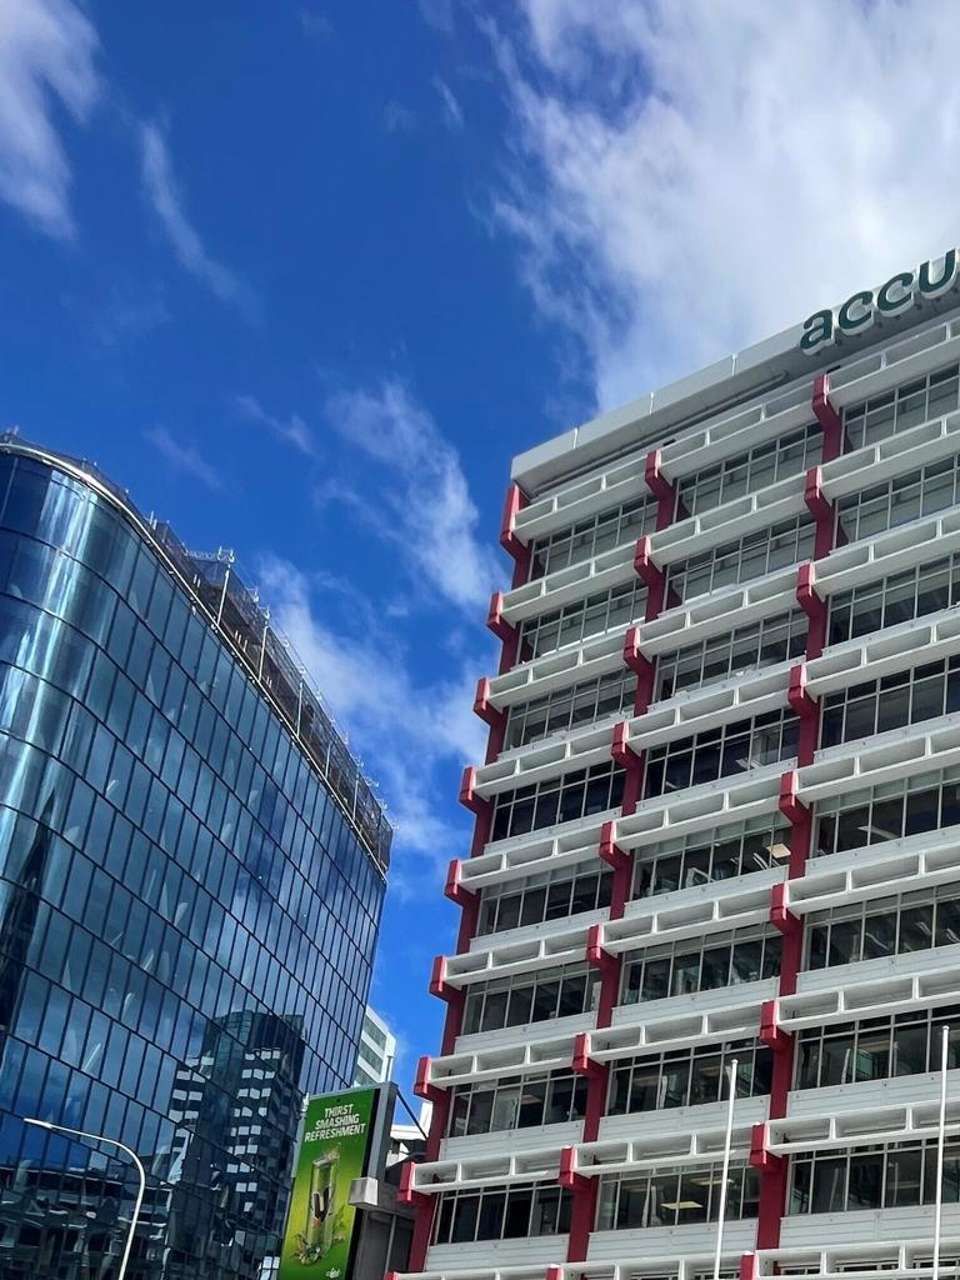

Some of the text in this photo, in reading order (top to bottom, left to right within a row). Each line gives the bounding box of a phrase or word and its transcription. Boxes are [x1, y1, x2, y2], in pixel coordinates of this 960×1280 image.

[324, 1104, 354, 1118] THIRST
[315, 1113, 360, 1130] SMASHING
[304, 1123, 367, 1142] REFRESHMENT
